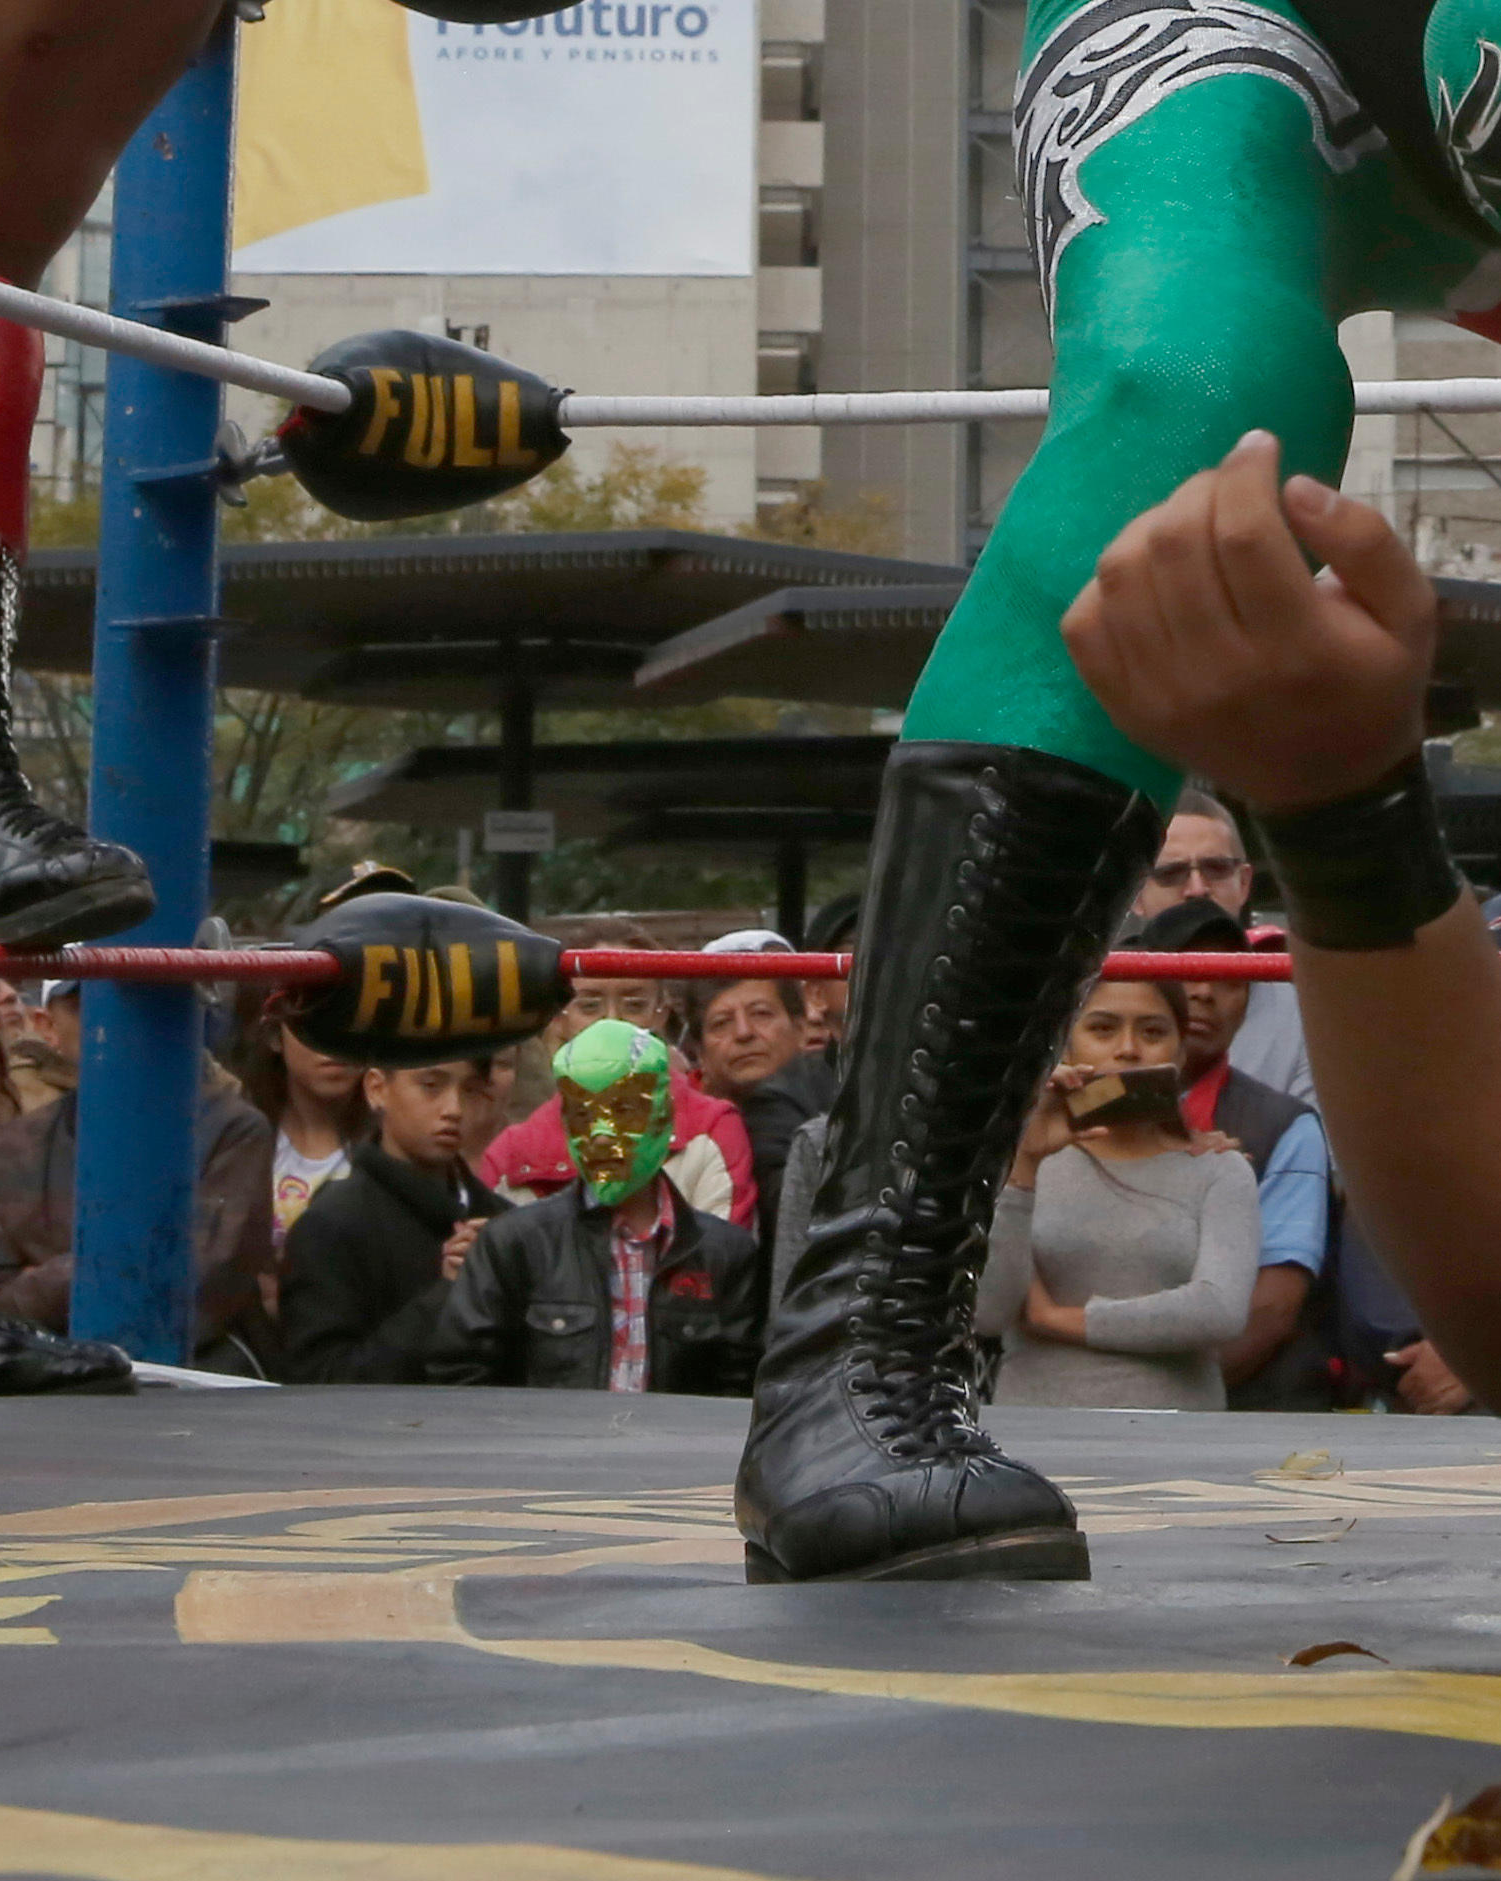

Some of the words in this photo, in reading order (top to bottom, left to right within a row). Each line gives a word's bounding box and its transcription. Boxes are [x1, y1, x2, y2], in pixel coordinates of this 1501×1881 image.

[436, 46, 525, 62] AFORE
[541, 47, 553, 62] Y
[569, 47, 720, 63] PENSIONES
[357, 367, 539, 470] FULL
[351, 940, 541, 1037] FULL
